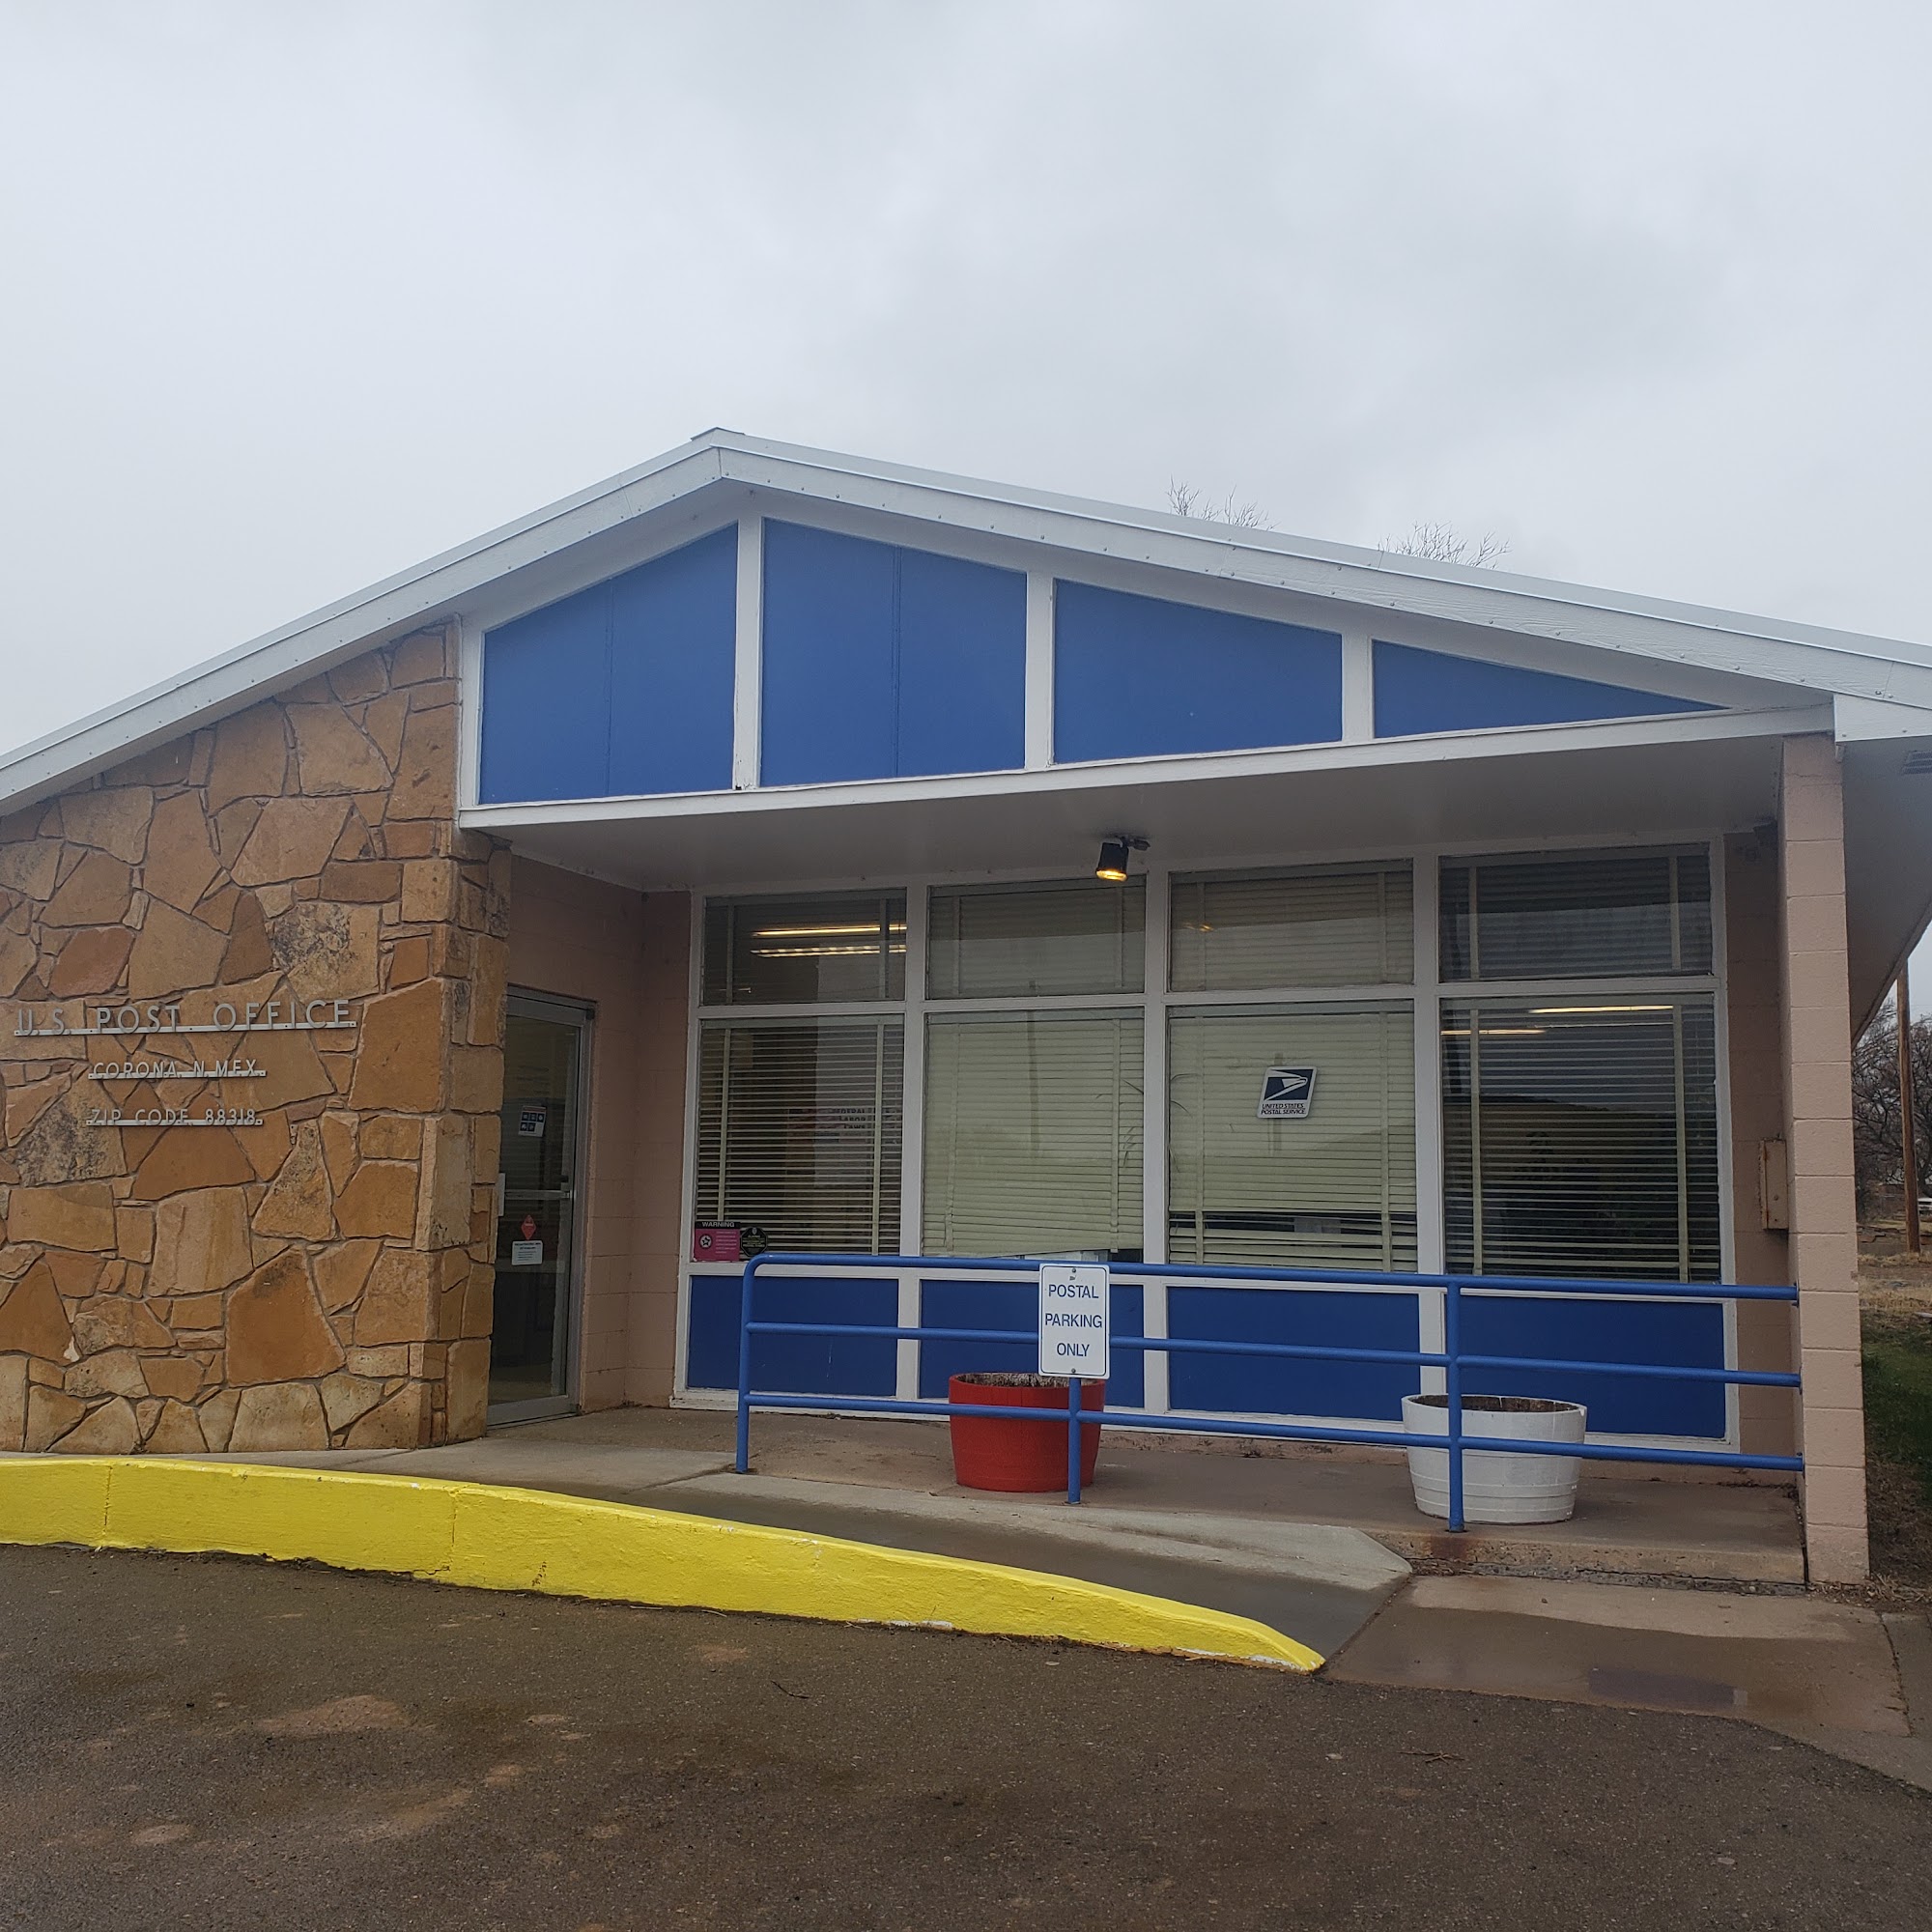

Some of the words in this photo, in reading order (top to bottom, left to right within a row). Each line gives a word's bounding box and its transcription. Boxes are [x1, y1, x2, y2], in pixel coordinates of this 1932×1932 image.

[98, 1005, 181, 1034] POST
[213, 999, 349, 1031] OFFICE
[92, 1109, 122, 1125] ZIP
[206, 1108, 256, 1126] 88318
[1048, 1284, 1099, 1298] POSTAL
[1044, 1313, 1102, 1328] PARKING
[1056, 1342, 1090, 1357] ONLY
